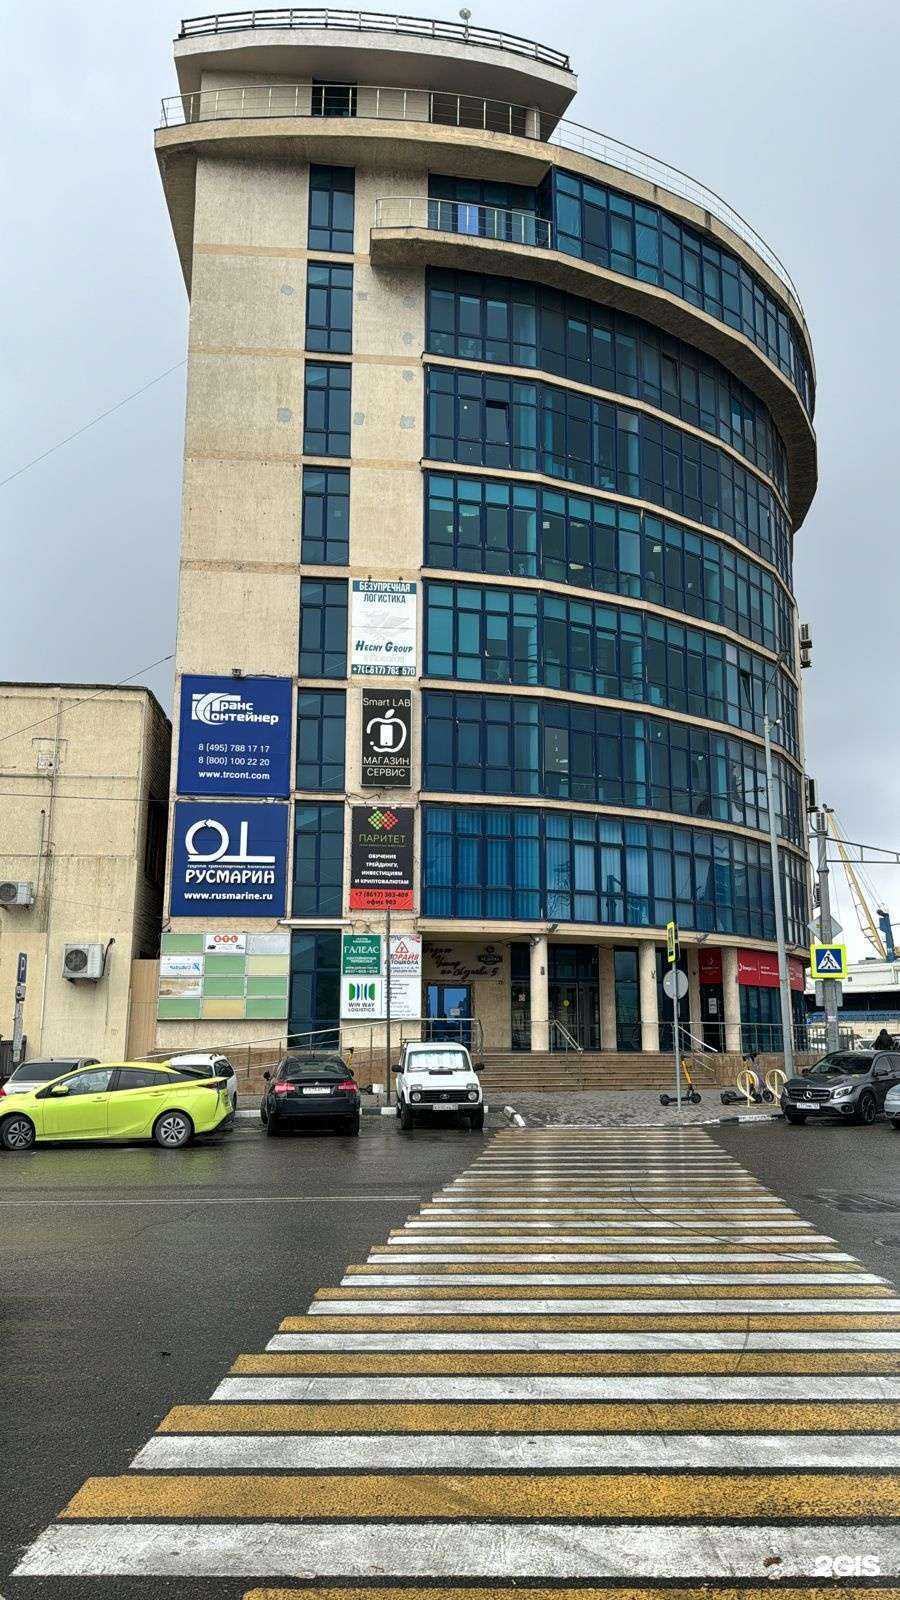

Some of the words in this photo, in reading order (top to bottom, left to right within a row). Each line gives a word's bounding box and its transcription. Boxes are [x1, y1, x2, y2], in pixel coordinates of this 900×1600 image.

[359, 582, 411, 592] БЕЗУПРЕЧНАЯ
[363, 593, 406, 603] ЛОГИСТИКА
[363, 697, 390, 706] Smart
[392, 698, 411, 707] LAB
[198, 743, 204, 751] 8
[206, 743, 228, 752] (495)
[230, 744, 246, 752] 788
[248, 745, 258, 753] 17
[260, 745, 270, 753] 17
[198, 756, 204, 764] 8
[206, 756, 228, 766] (800)
[231, 757, 246, 766] 100
[247, 758, 258, 766] 22
[260, 758, 270, 767] 20
[363, 756, 410, 765] МАГАЗИН
[198, 771, 270, 780] www.trcont.com
[366, 767, 406, 777] СЕРВИС
[359, 833, 406, 843] ПАРИТЕТ
[185, 869, 275, 884] РУСМАРИН
[184, 891, 273, 900] www.rusmarine.ru
[344, 945, 380, 954] ГАЛЕАС
